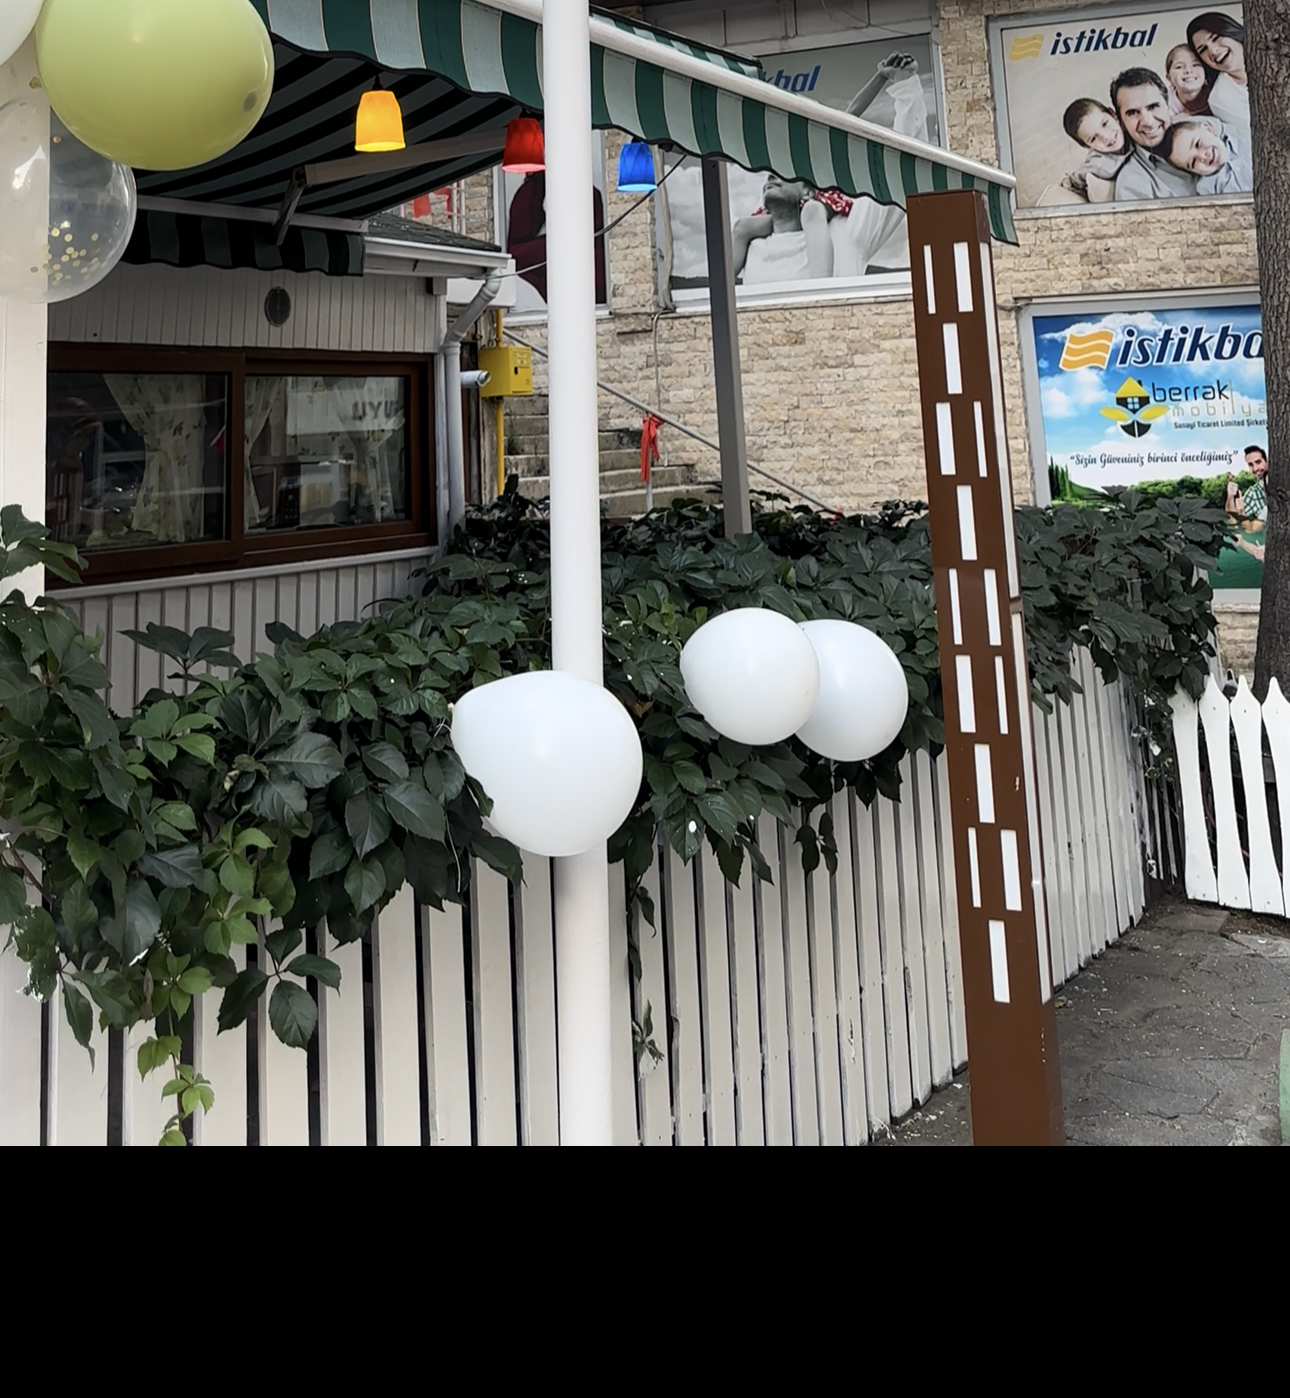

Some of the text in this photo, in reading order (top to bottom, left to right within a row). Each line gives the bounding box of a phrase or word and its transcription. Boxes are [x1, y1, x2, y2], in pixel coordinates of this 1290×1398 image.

[1050, 23, 1158, 56] istikbal
[1118, 324, 1265, 366] istikba
[1151, 379, 1230, 403] berrak
[1197, 420, 1220, 428] Ticaret
[1220, 418, 1245, 428] Limited
[1147, 451, 1178, 463] birinci
